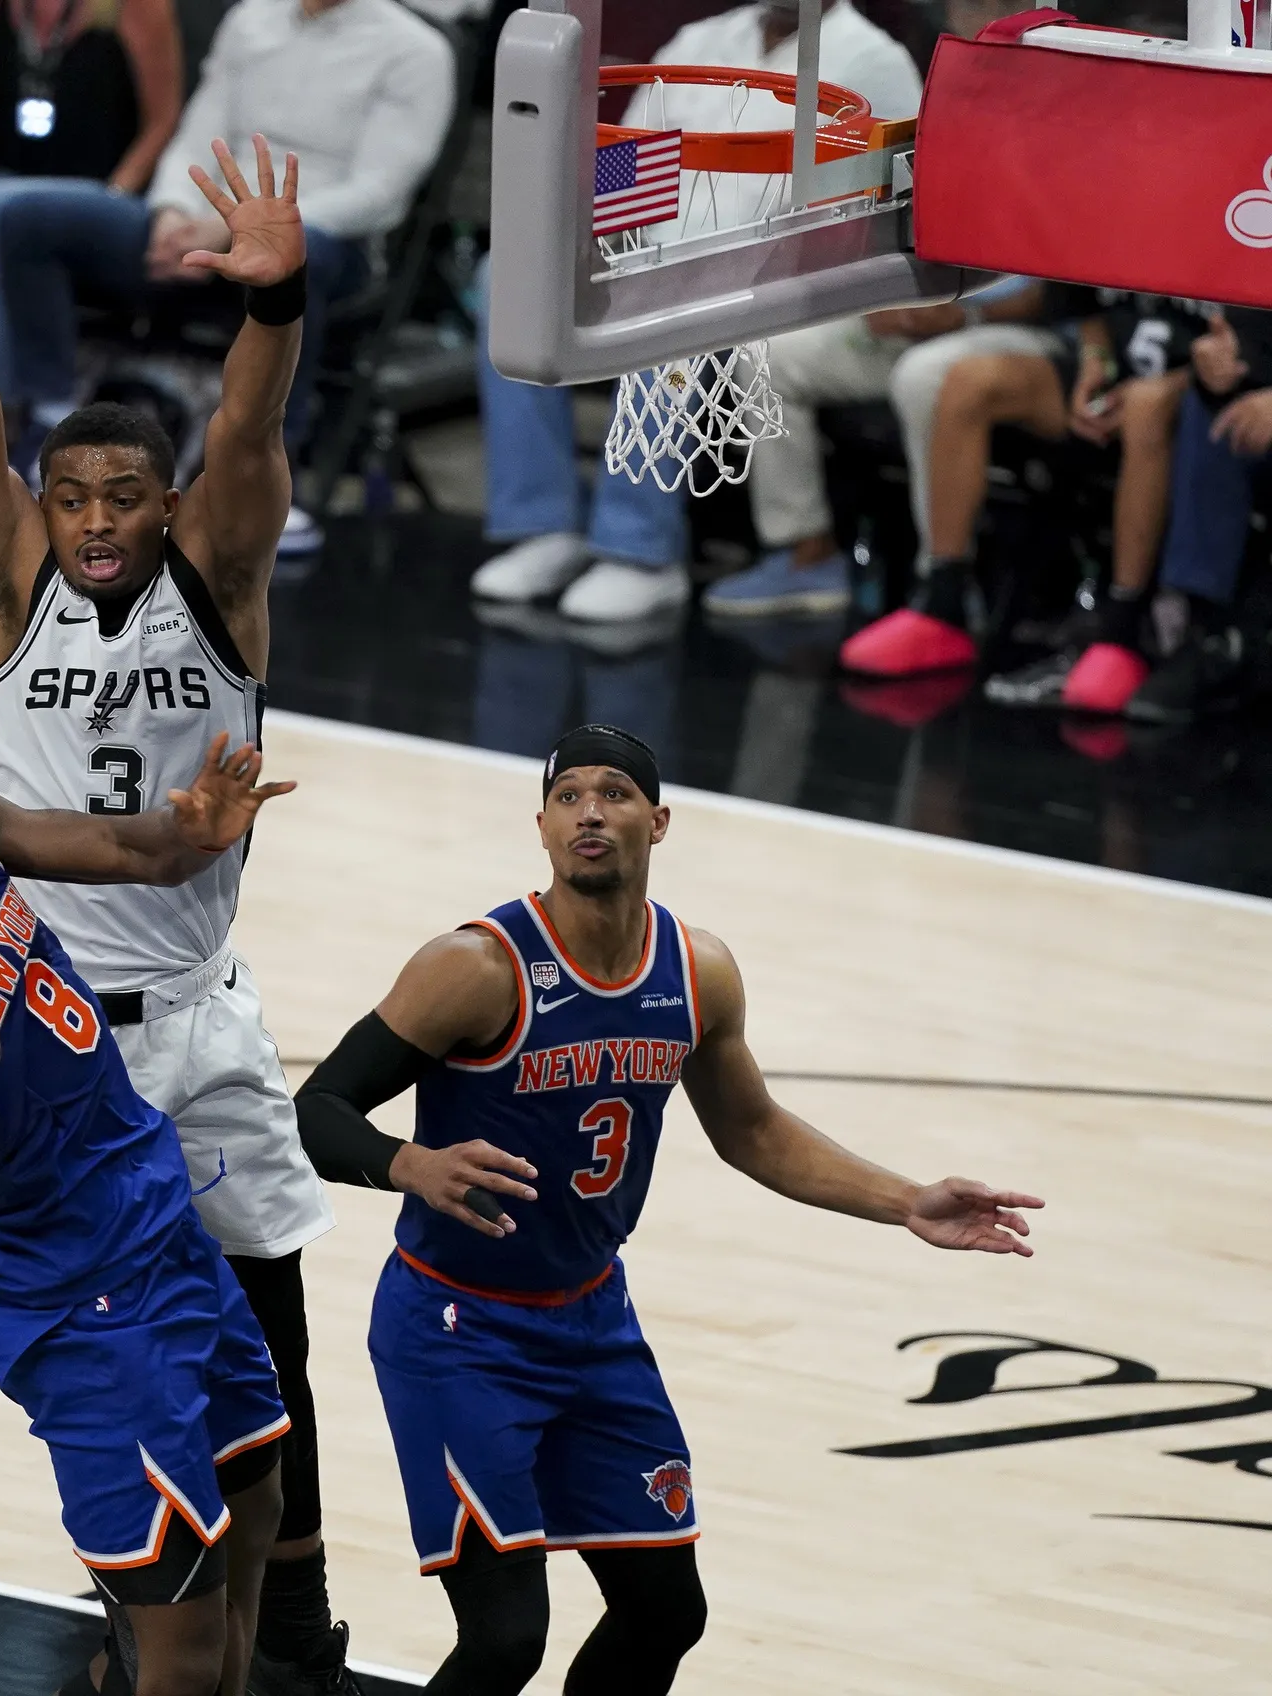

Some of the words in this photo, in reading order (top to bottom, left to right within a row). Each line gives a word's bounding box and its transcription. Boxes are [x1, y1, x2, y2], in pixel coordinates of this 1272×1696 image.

[1128, 319, 1171, 378] 5
[25, 666, 211, 734] SPURS
[86, 743, 146, 816] 3
[24, 957, 102, 1054] 8
[535, 975, 557, 983] 250
[513, 1041, 605, 1094] NEW
[605, 1036, 691, 1084] YORK
[570, 1097, 634, 1200] 3
